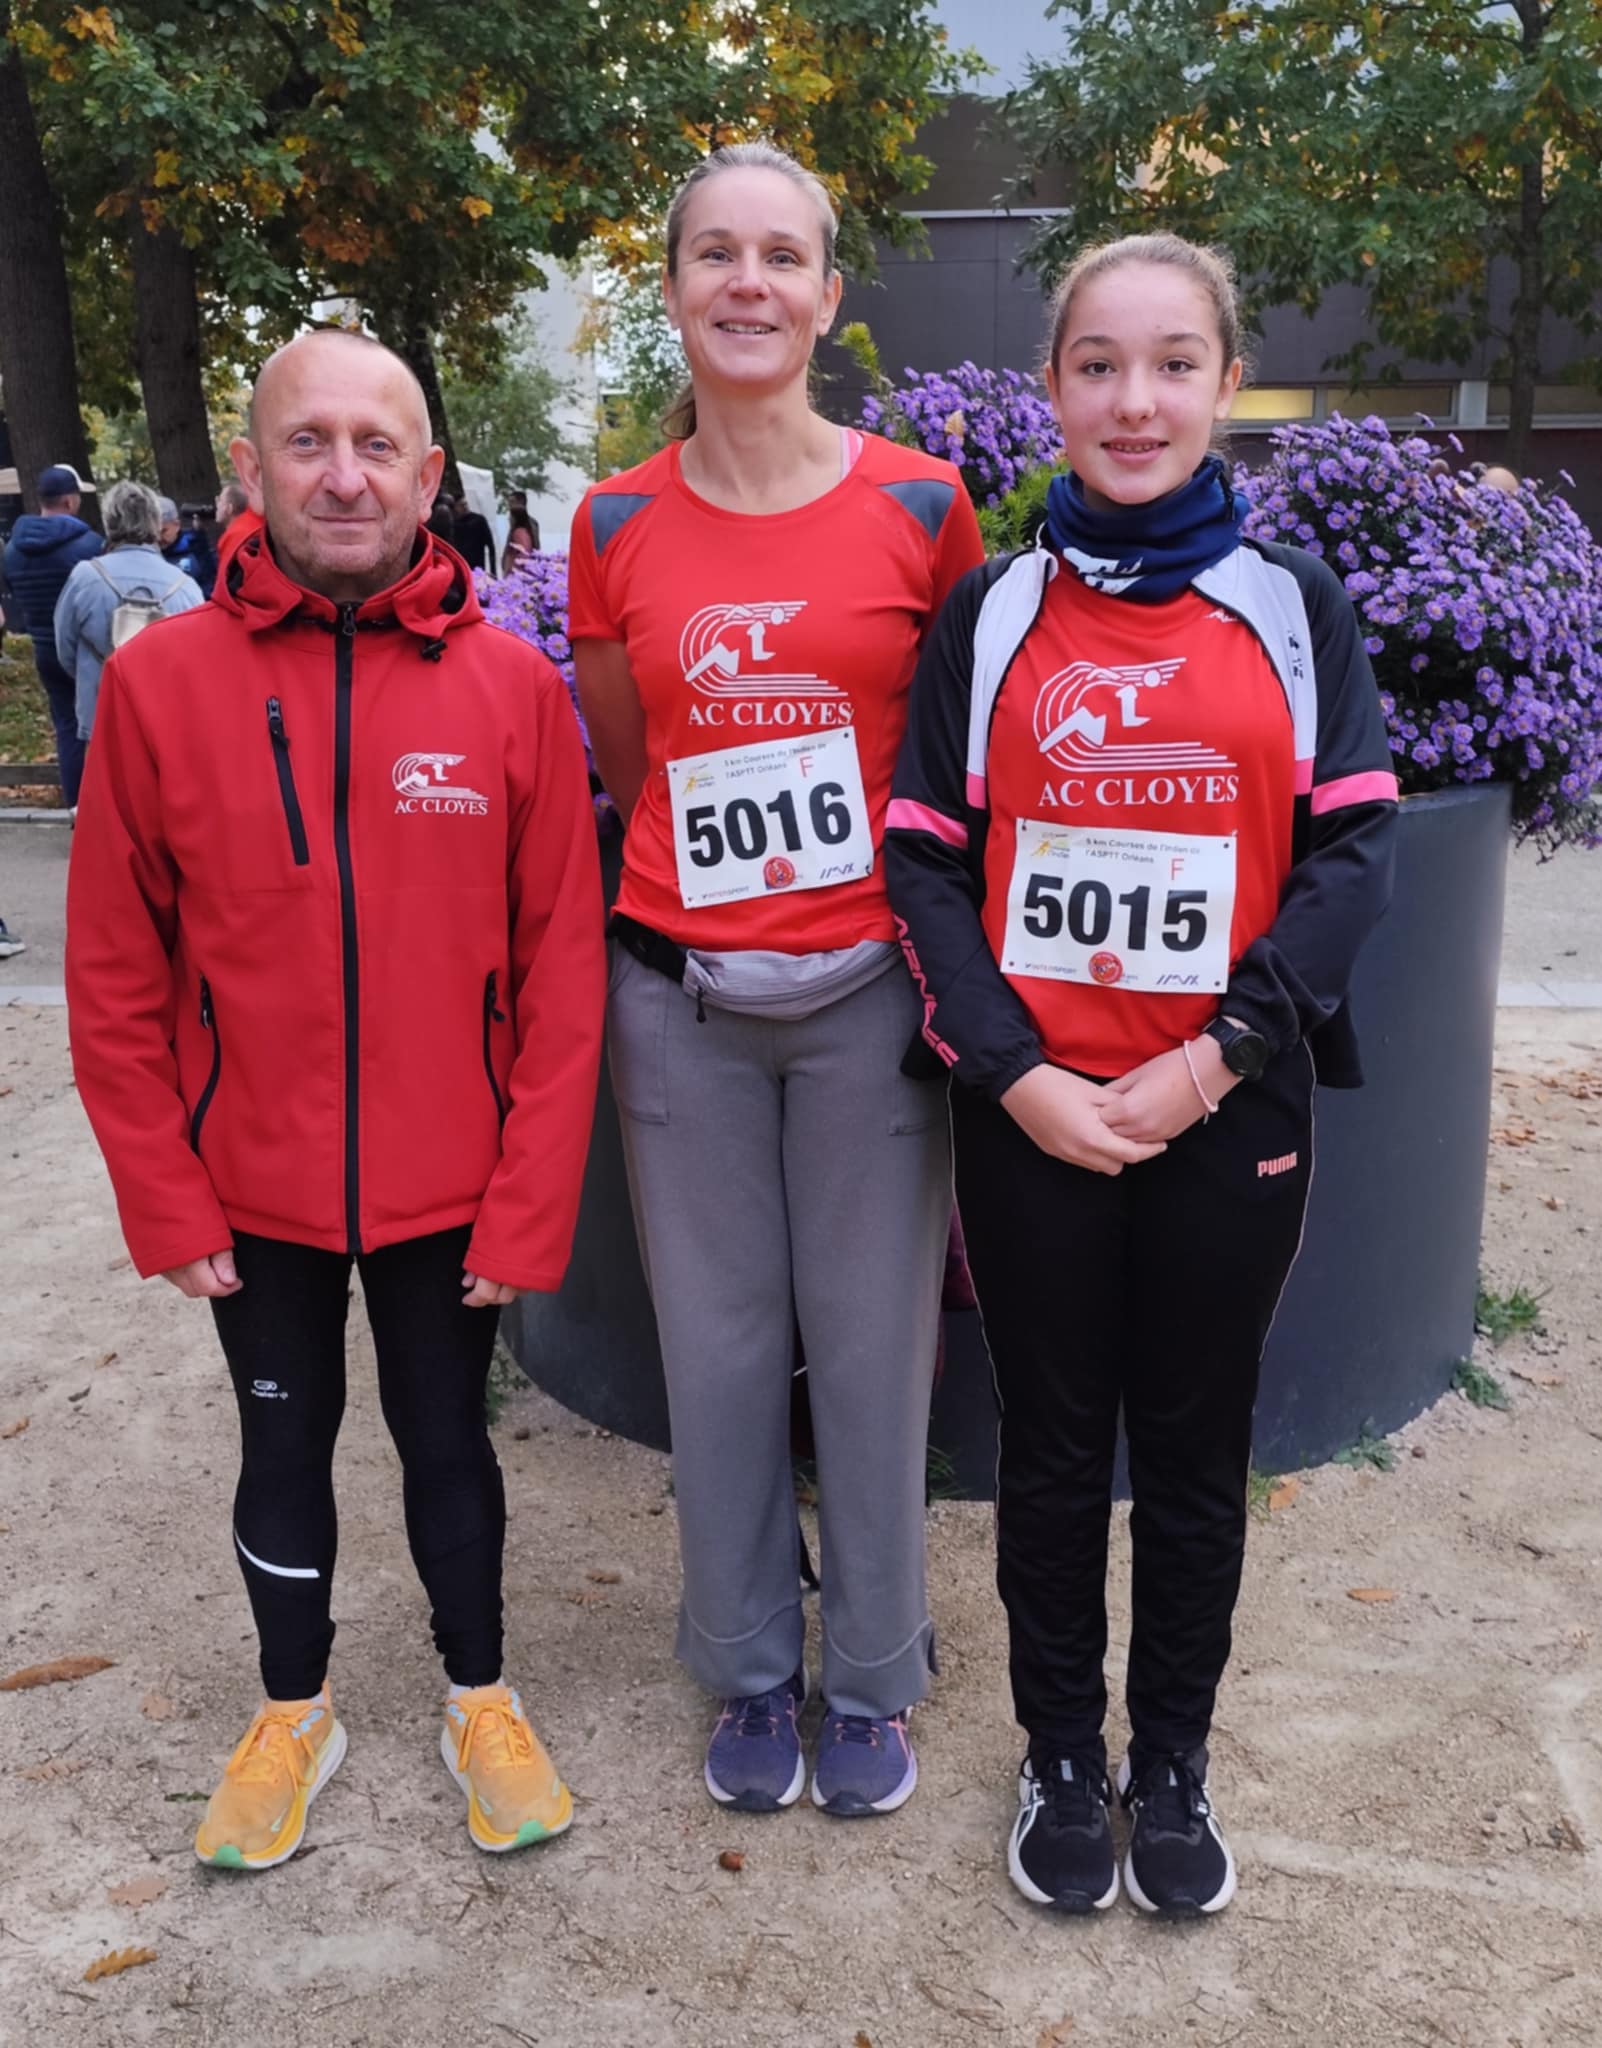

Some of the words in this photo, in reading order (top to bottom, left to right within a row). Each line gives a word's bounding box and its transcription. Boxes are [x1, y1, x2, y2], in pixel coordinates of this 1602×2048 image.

[688, 703, 724, 725] AC
[732, 702, 853, 726] CLOYES
[799, 756, 814, 778] F
[1038, 779, 1085, 807] AC
[1095, 775, 1240, 806] CLOYES
[394, 799, 418, 814] AC
[422, 798, 488, 815] CLOYES
[686, 781, 852, 868] 5016
[1093, 838, 1107, 846] km
[1109, 839, 1145, 850] Courses
[1171, 858, 1184, 881] F
[1024, 873, 1208, 952] 5015
[1257, 1150, 1297, 1178] PUMA
